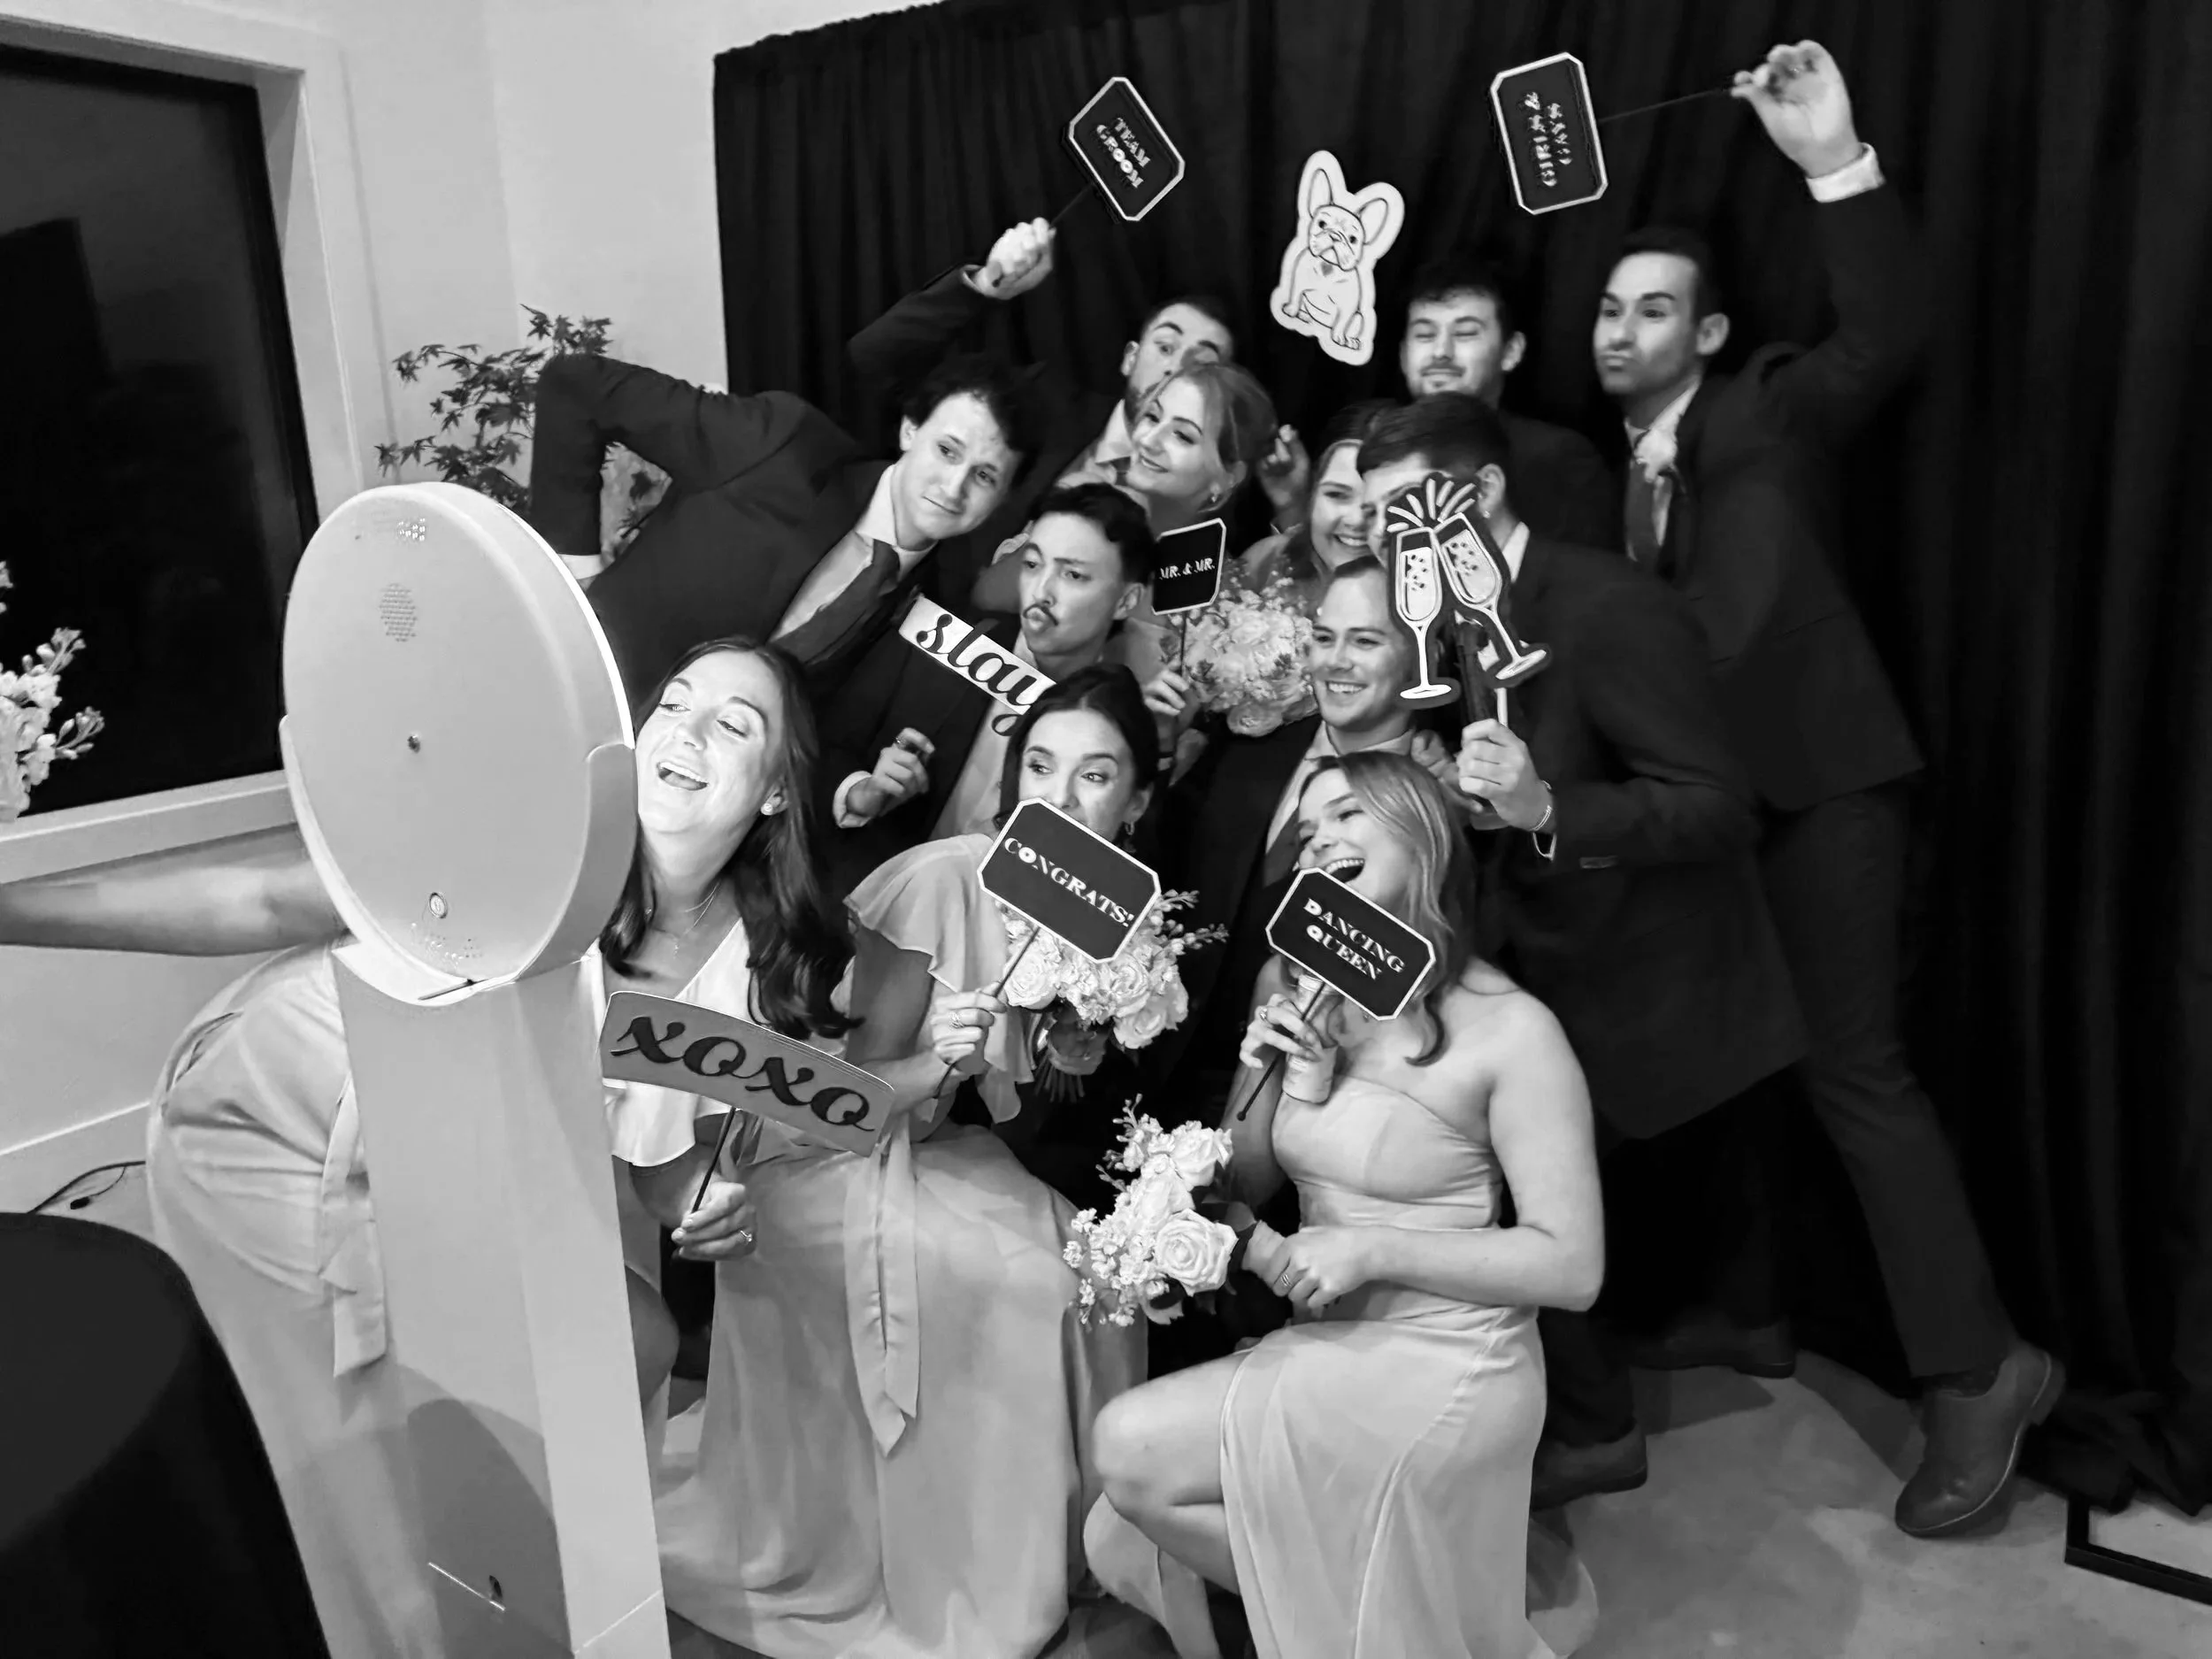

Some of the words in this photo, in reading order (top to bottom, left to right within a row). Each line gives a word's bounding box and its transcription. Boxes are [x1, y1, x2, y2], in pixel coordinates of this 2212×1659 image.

[1096, 124, 1144, 188] GROOM
[1115, 117, 1150, 167] TEAM
[1159, 565, 1181, 580] MR.
[1182, 563, 1193, 575] &
[1194, 557, 1216, 573] MR.
[1004, 837, 1135, 927] CONGRATS!
[1303, 897, 1405, 972] DANCING
[1306, 925, 1382, 980] QUEEN
